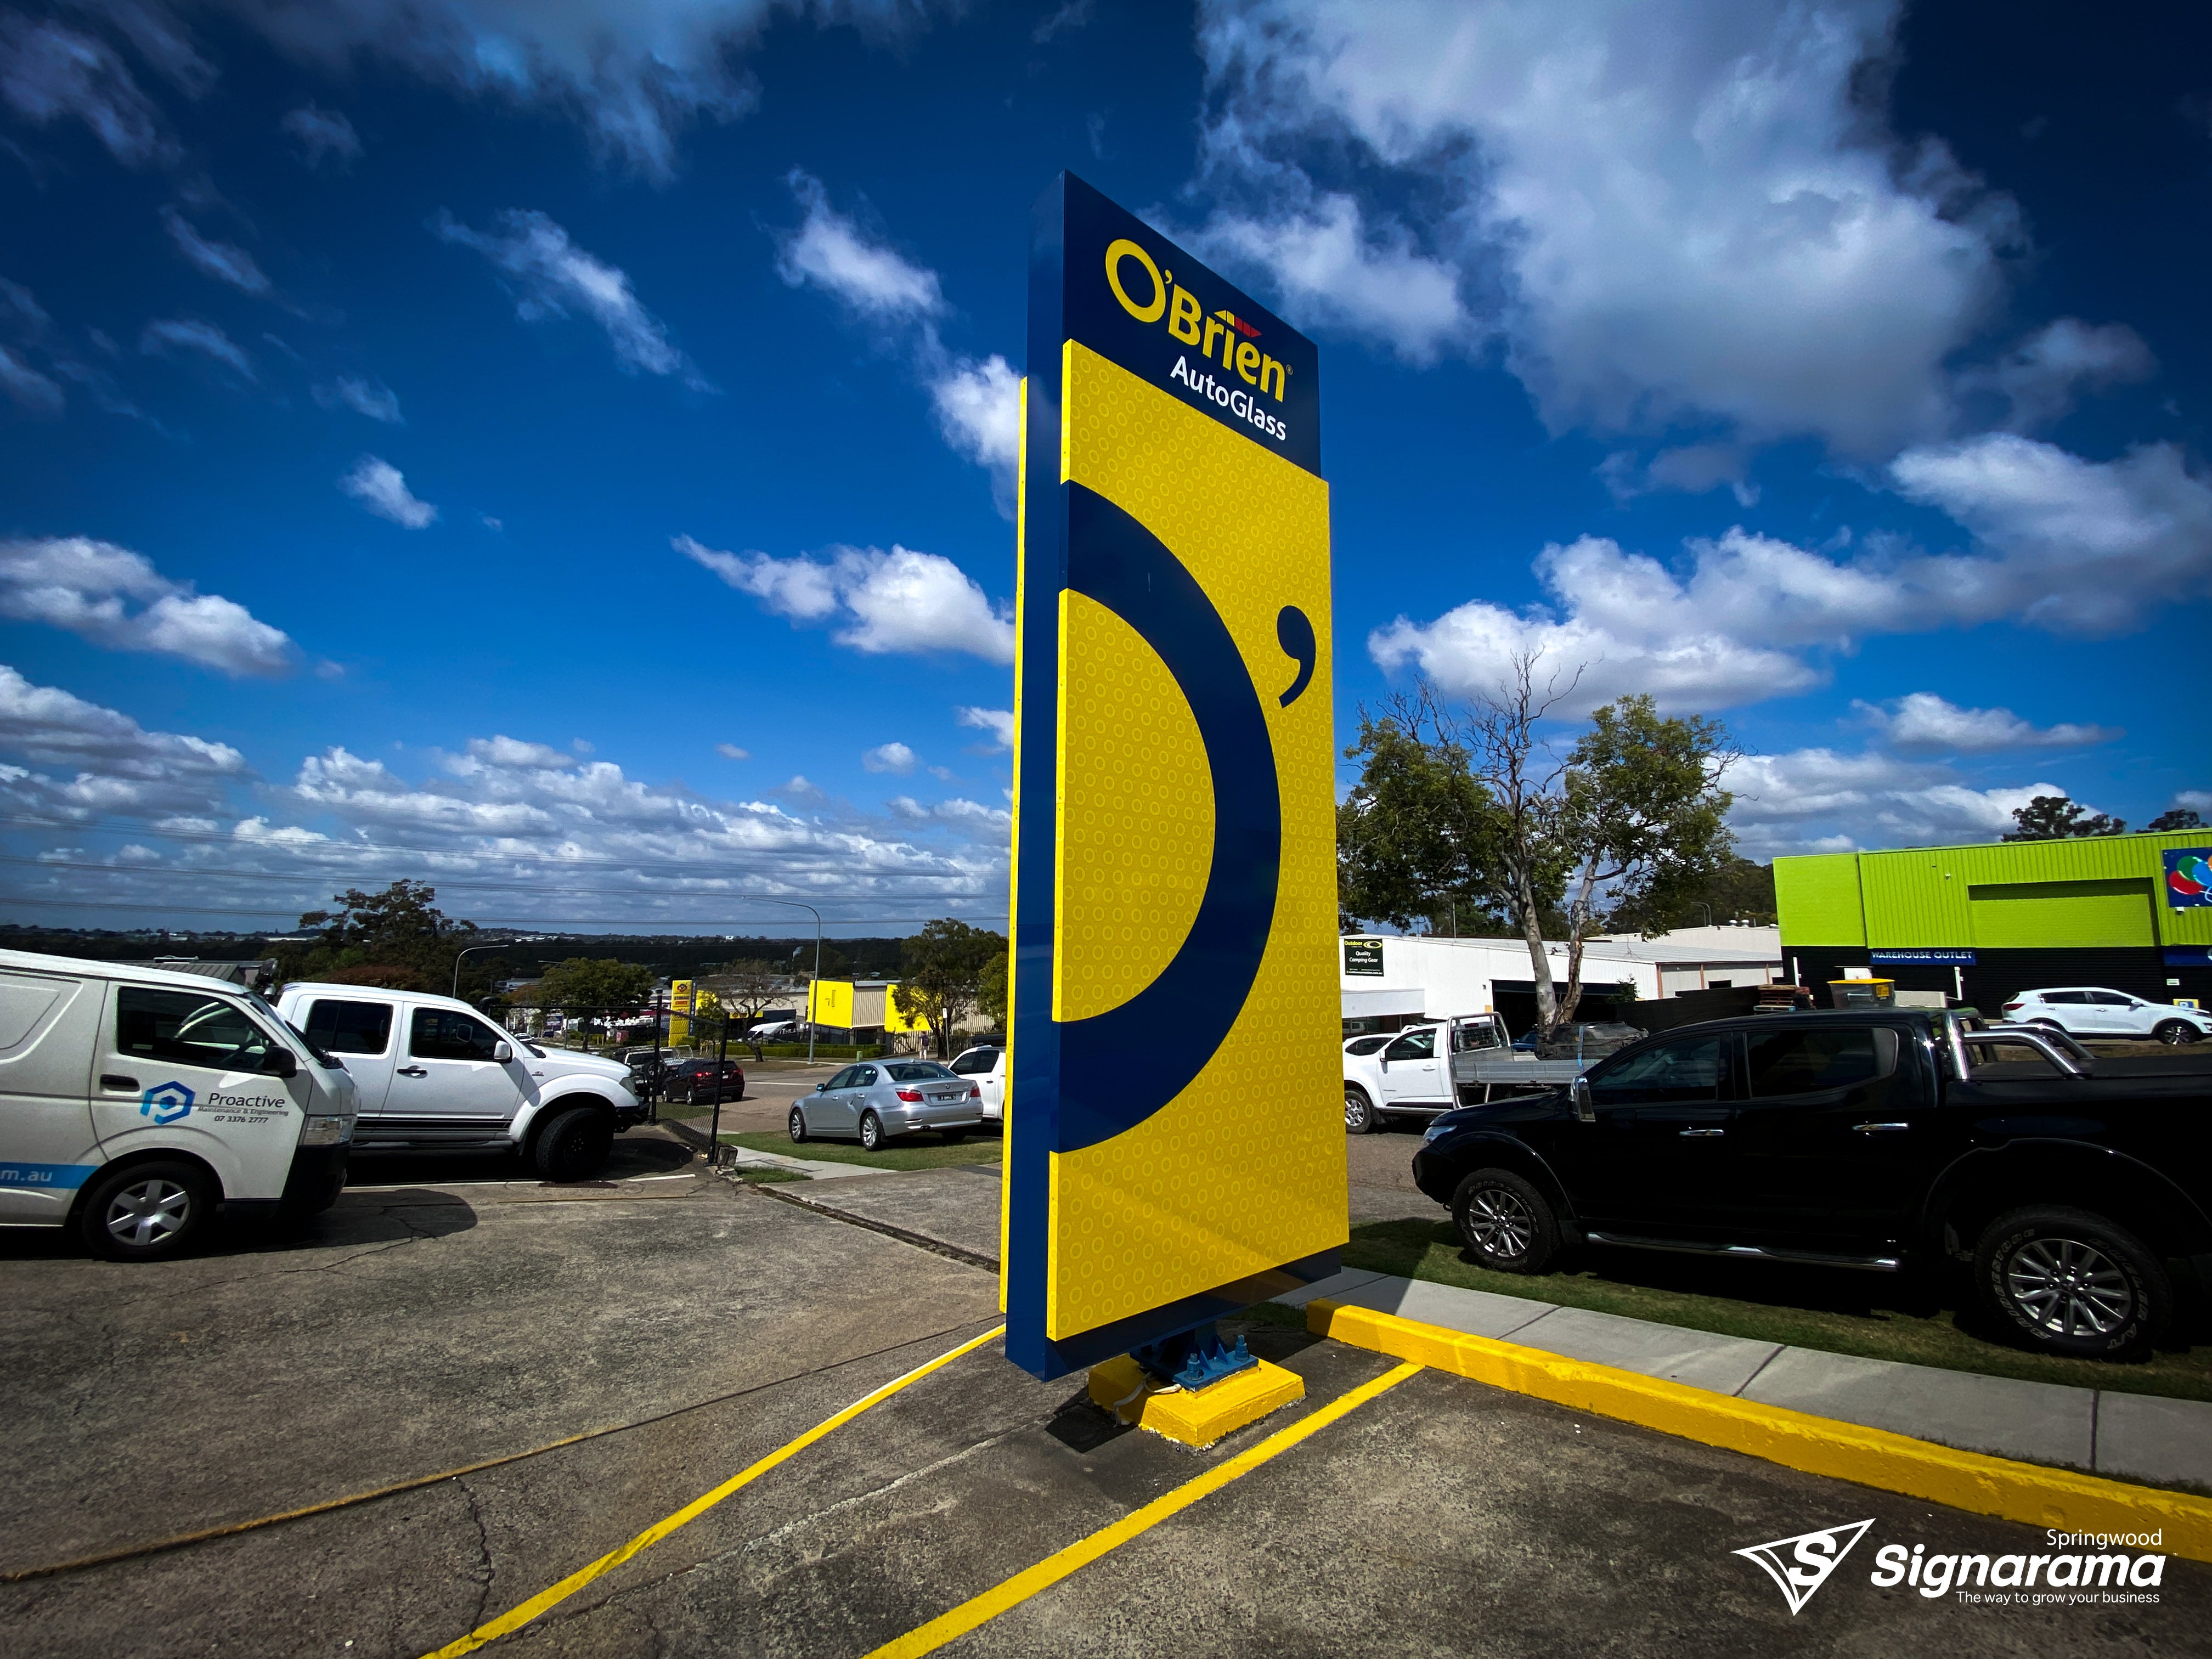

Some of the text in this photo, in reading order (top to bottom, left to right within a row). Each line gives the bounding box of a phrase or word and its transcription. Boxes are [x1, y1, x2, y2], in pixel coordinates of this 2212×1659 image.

[1105, 238, 1286, 403] O'Brien
[1170, 355, 1287, 441] AutoGlass
[1871, 951, 1932, 959] WAREHOUSE
[208, 1092, 285, 1108] Proactive
[197, 1106, 242, 1114] Maintenance
[250, 1108, 290, 1117] Engineering
